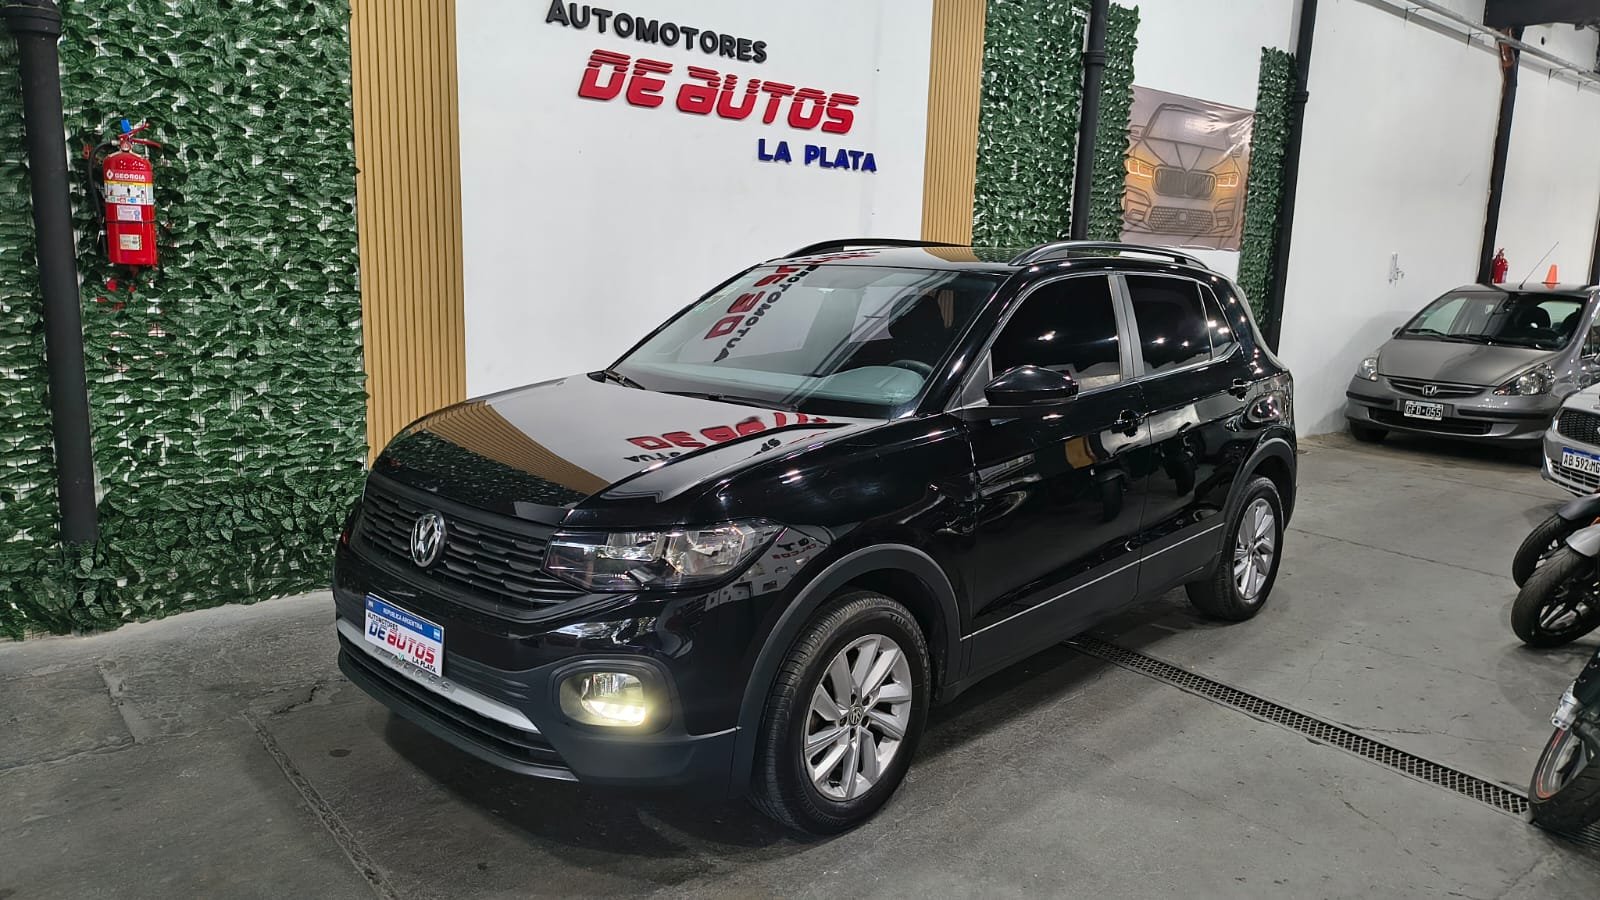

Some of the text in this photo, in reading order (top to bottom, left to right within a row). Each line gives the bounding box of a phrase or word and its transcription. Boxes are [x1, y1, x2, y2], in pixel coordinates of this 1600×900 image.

[546, 0, 768, 64] AUTOMOTORES
[578, 49, 673, 108] DE
[758, 138, 877, 173] LA PLATA
[115, 172, 145, 180] GEORGIA
[1563, 453, 1574, 466] AB
[1575, 456, 1590, 471] 592
[367, 612, 399, 631] AUTOMOTORES
[368, 620, 388, 641] DE
[420, 660, 437, 673] PLATA
